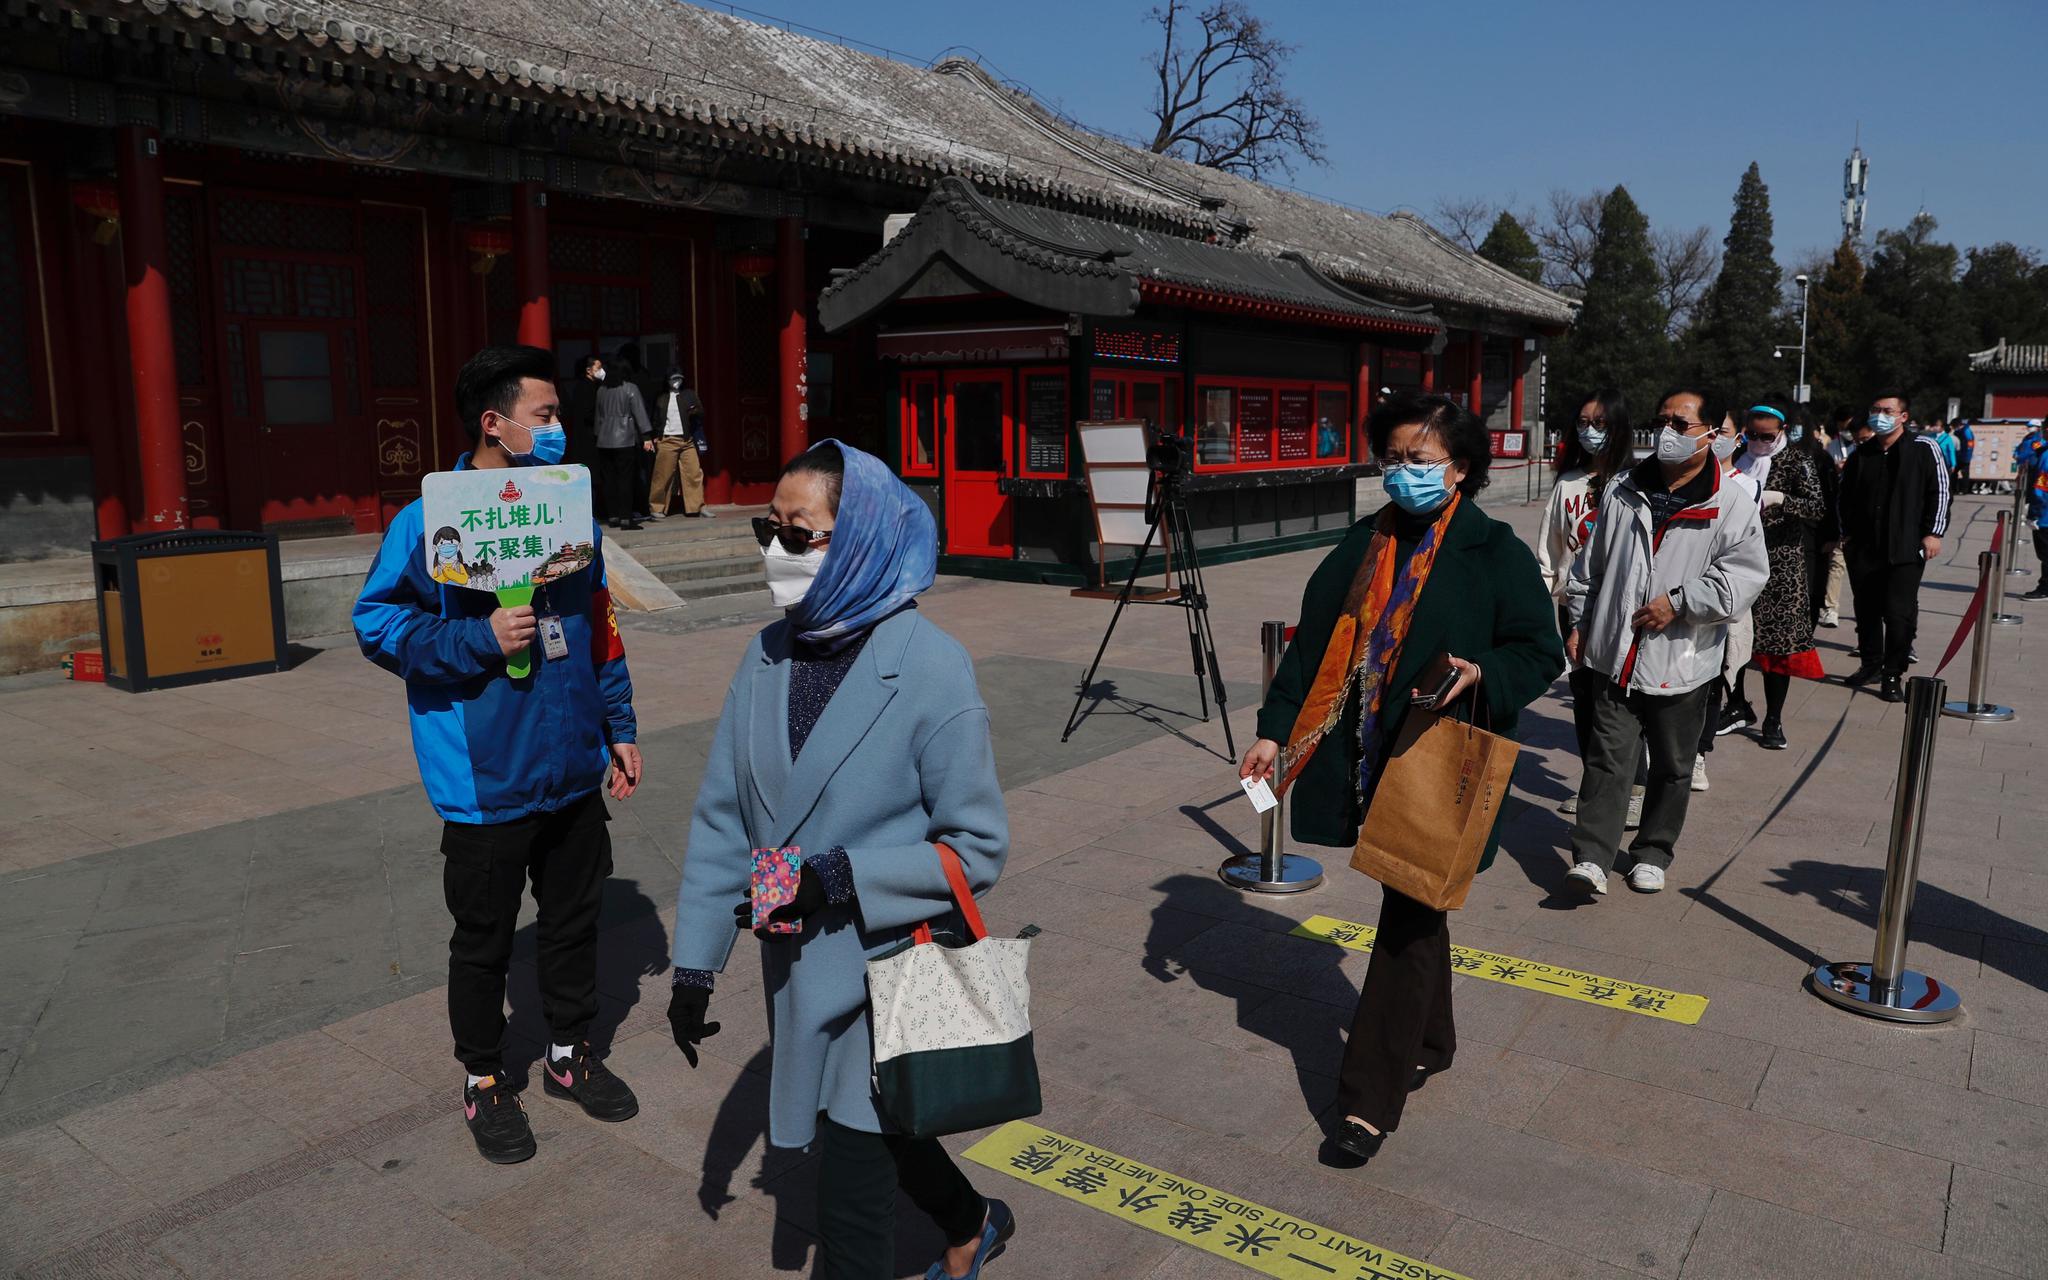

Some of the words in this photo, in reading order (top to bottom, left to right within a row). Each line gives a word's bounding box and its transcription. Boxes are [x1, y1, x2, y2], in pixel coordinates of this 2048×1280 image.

[460, 503, 563, 532] 不扎堆儿！
[1337, 922, 1374, 934] LINE
[1471, 951, 1511, 964] SIDE
[1513, 960, 1551, 973] OUT
[1554, 969, 1598, 983] WAIT
[1604, 980, 1676, 1000] PLEASE
[1036, 1134, 1085, 1157] LINE
[1084, 1151, 1159, 1183] METER
[1157, 1177, 1208, 1201] ONE
[1208, 1195, 1265, 1221] SIDE
[1264, 1217, 1318, 1241] OUT
[1319, 1236, 1383, 1266] WAIT
[1387, 1258, 1455, 1280] ASE
